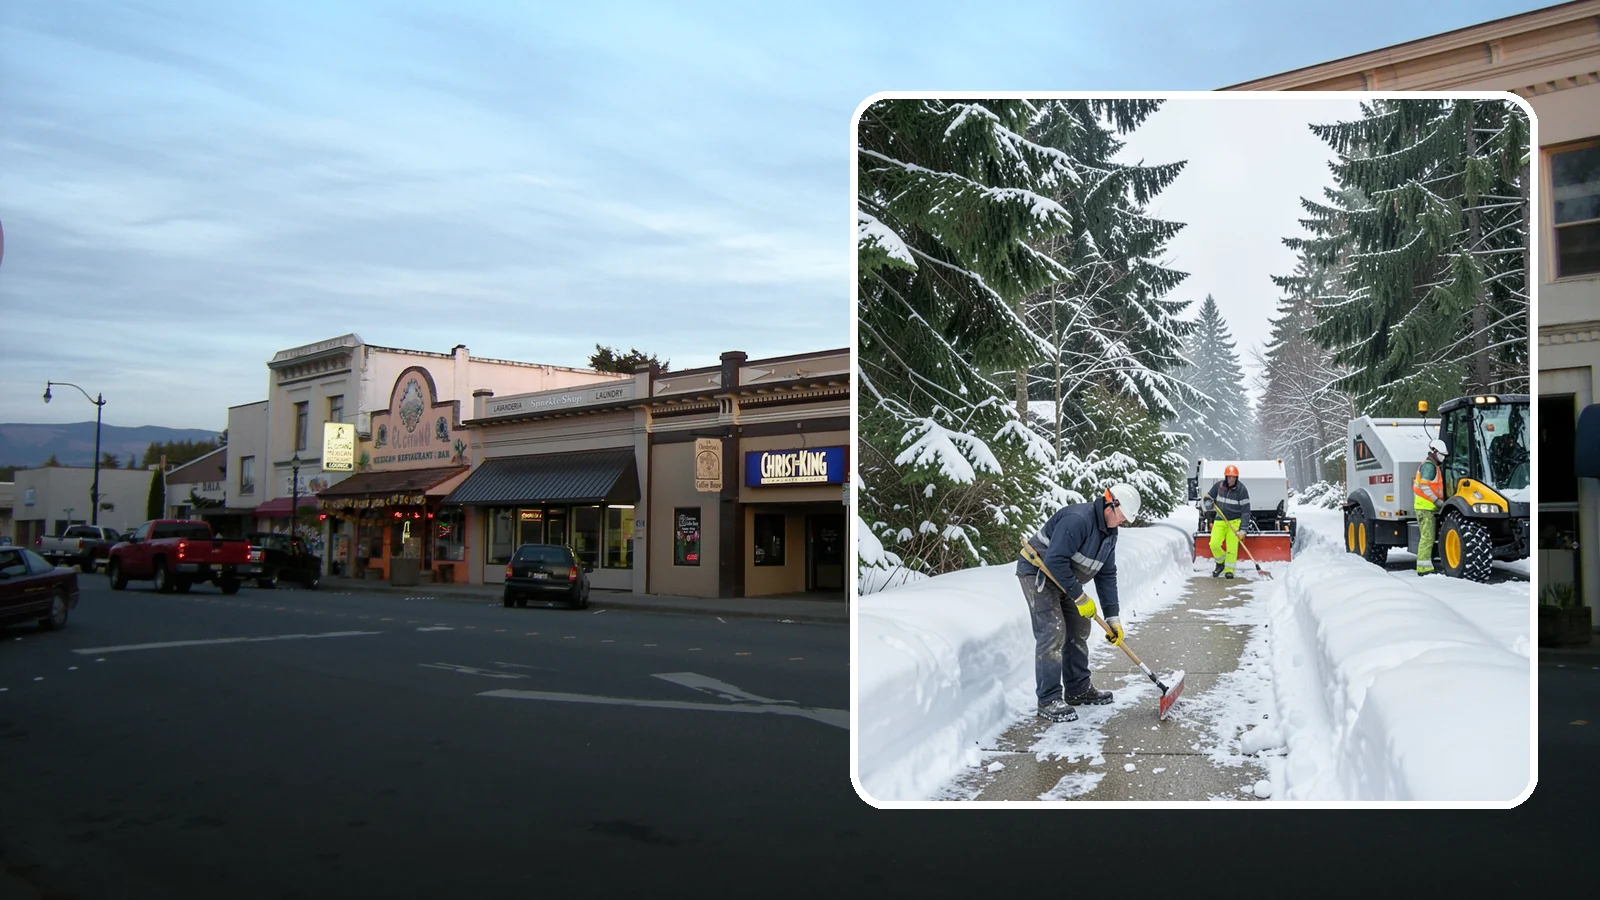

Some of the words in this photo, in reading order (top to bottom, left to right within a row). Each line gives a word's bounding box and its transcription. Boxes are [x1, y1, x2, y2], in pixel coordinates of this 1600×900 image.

[493, 402, 523, 412] LAVANDERIA
[562, 394, 582, 404] Shop
[595, 389, 623, 400] LAUNDRY
[373, 454, 396, 465] MEXICAN
[397, 451, 433, 462] RESTAURANT
[438, 450, 450, 459] BAR
[799, 449, 827, 476] KING
